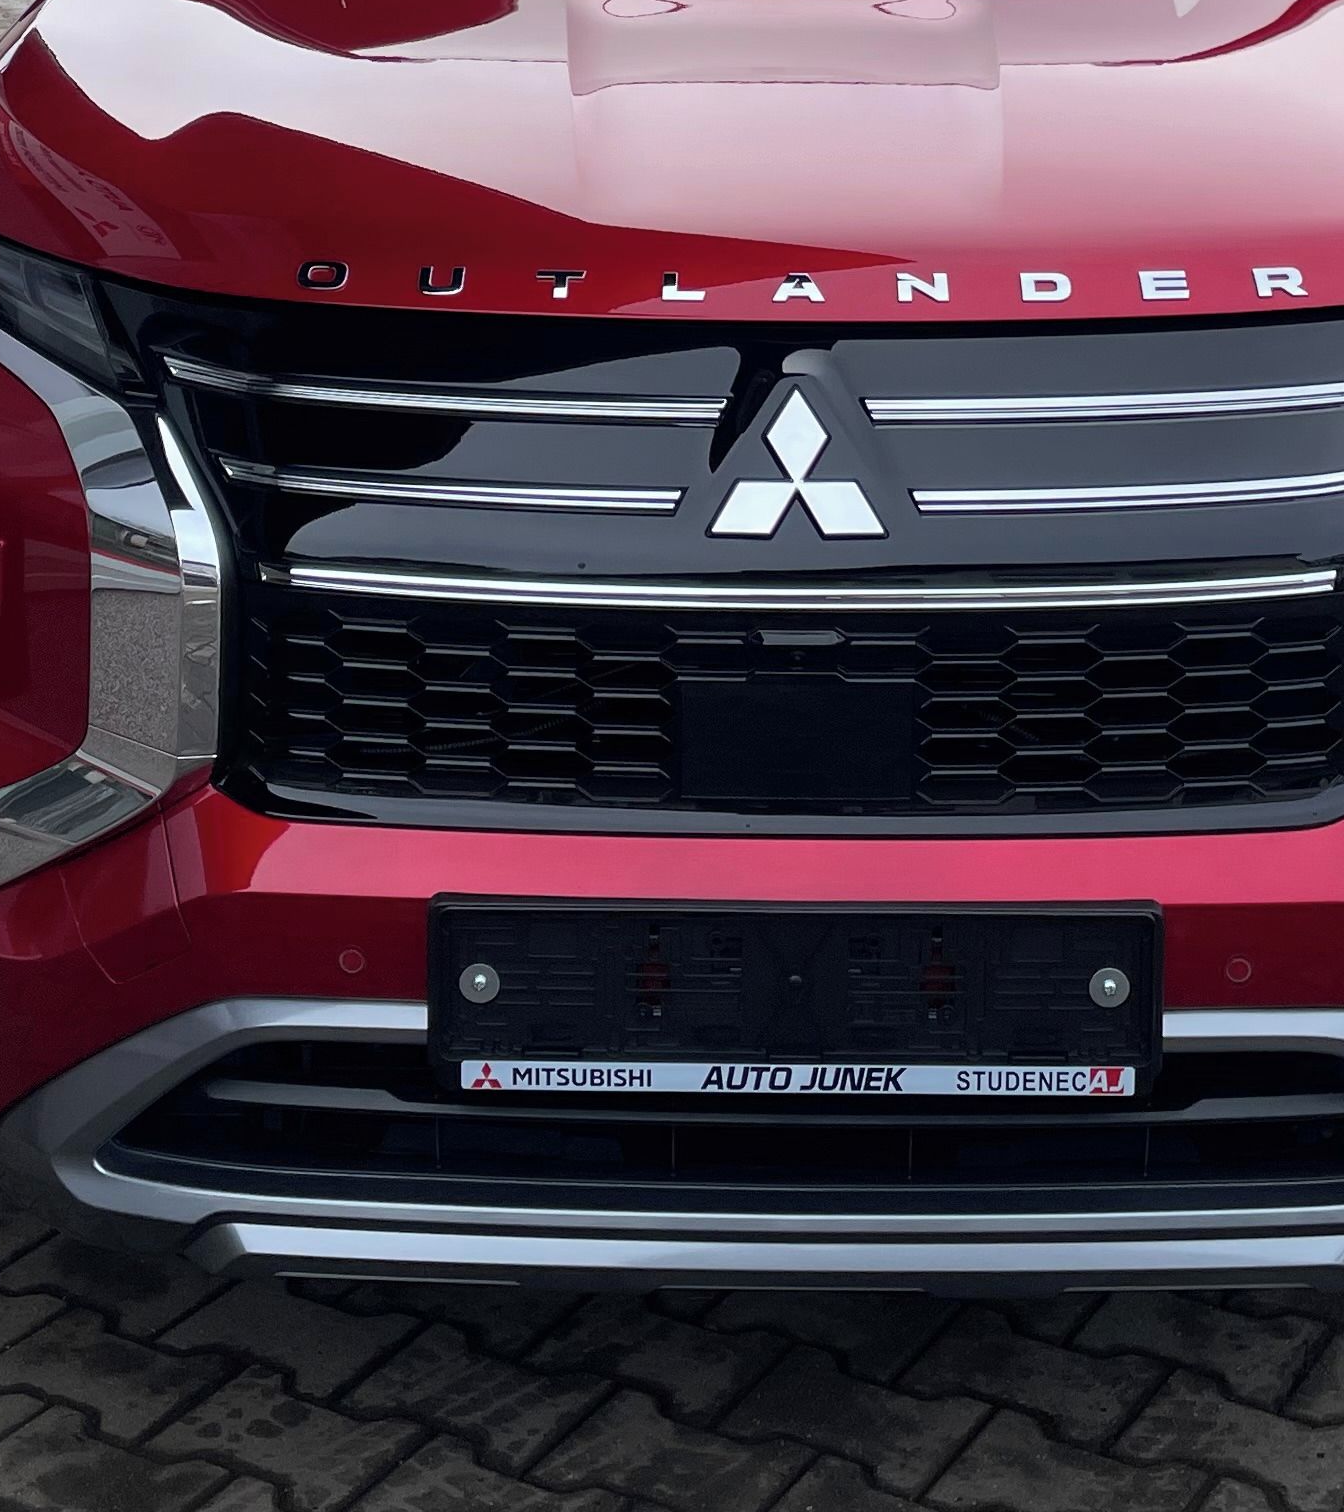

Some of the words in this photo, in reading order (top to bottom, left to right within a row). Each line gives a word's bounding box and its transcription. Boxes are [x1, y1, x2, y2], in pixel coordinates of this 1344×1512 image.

[296, 260, 1309, 303] OUTLANDER
[511, 1067, 653, 1089] MITSUBISHI
[700, 1066, 794, 1091] AUTO
[798, 1066, 905, 1092] JUNEK
[956, 1070, 1087, 1093] STUDENEC
